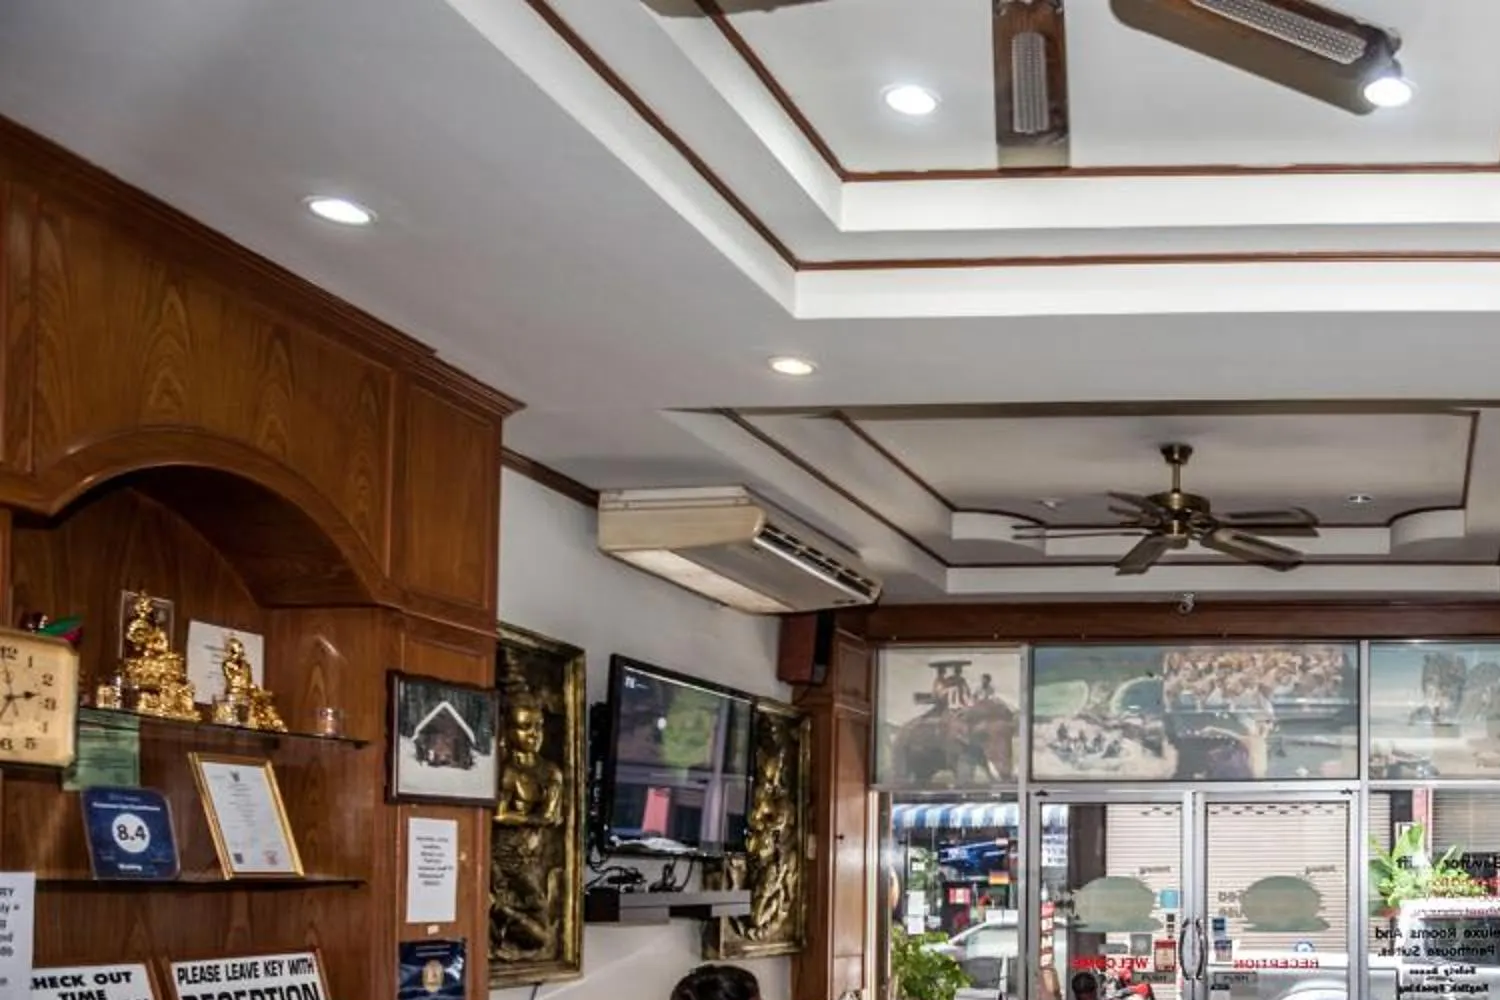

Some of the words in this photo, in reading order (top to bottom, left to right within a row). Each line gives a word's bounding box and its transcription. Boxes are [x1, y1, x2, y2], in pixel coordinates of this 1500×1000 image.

[41, 672, 54, 687] 2
[116, 823, 147, 842] 8.4
[177, 964, 222, 985] PLEASE
[225, 961, 260, 982] LEAVE
[263, 959, 285, 977] KEY
[287, 956, 315, 976] WITH
[30, 974, 87, 991] HECK
[93, 971, 132, 986] OUT
